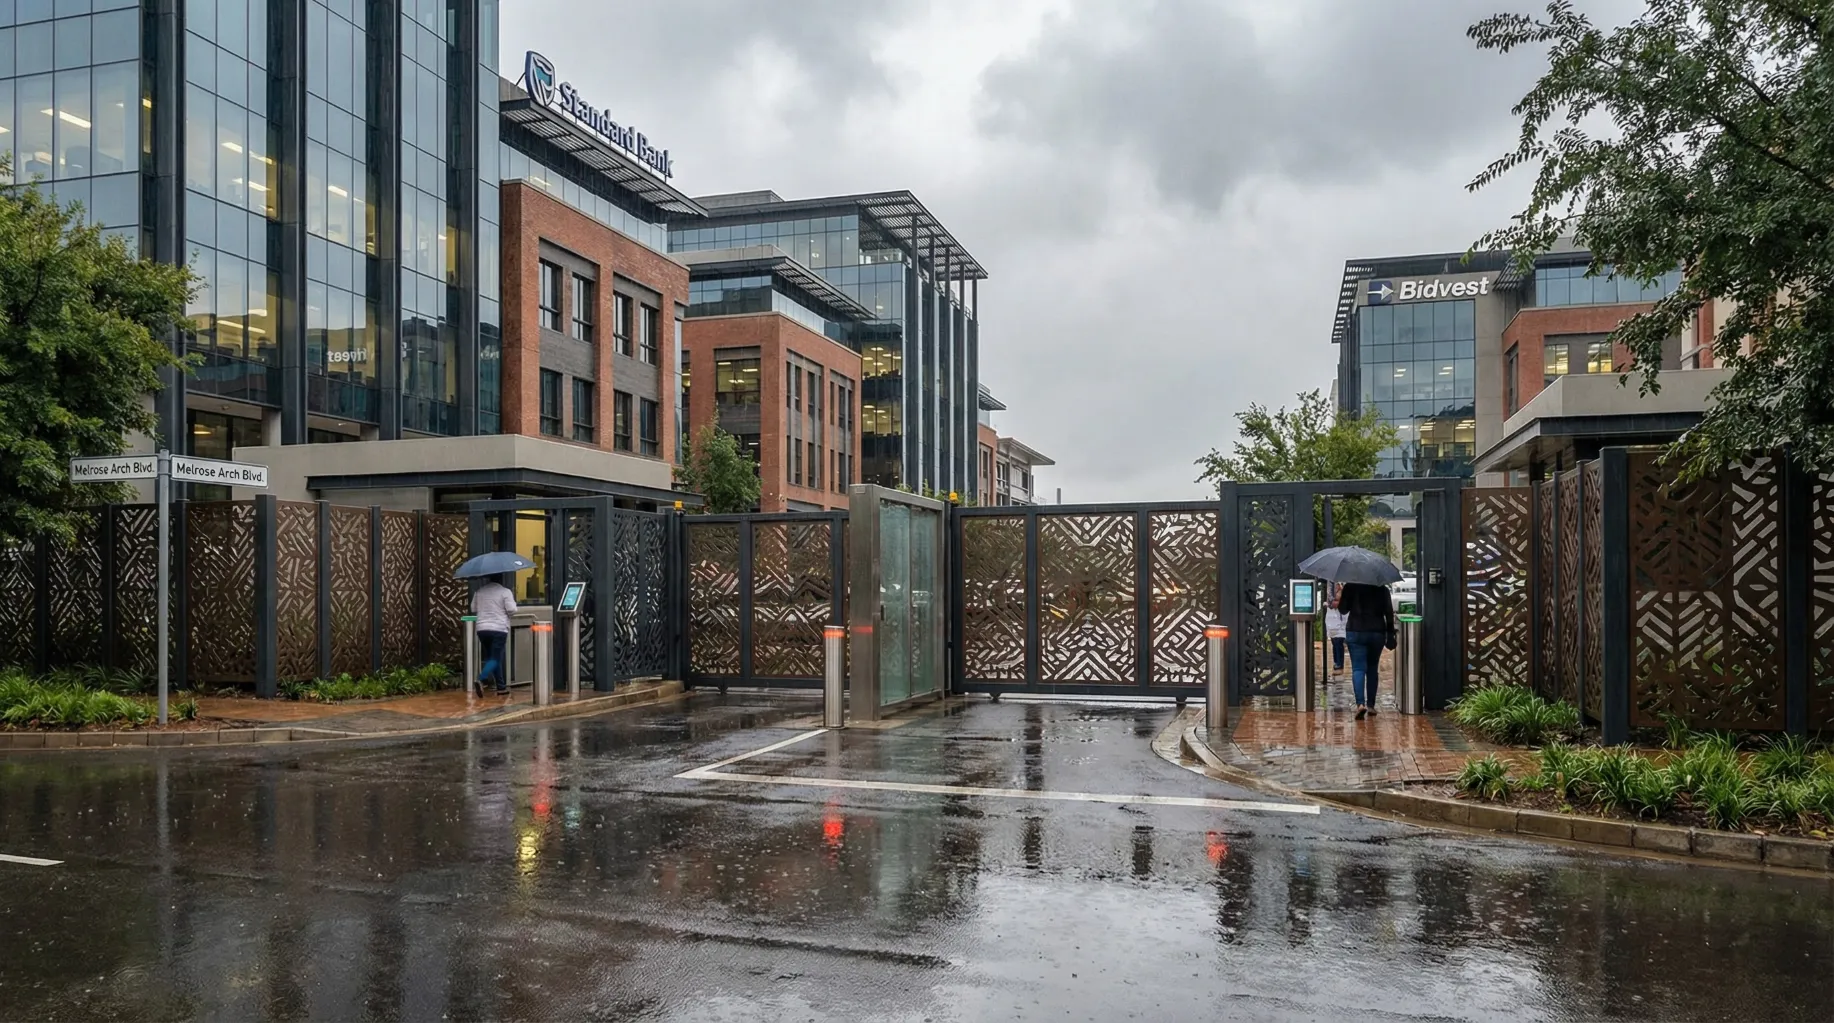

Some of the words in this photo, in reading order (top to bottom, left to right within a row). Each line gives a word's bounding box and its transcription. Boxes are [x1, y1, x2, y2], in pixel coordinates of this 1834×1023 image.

[559, 81, 635, 151] Standard
[637, 132, 674, 178] Bank
[1400, 276, 1490, 300] Bidvest
[75, 464, 109, 476] Melrose
[111, 463, 131, 475] Arch
[133, 462, 155, 474] Blvd.
[176, 463, 216, 477] Melrose
[218, 466, 240, 479] Arch
[242, 469, 265, 482] Blvd.
